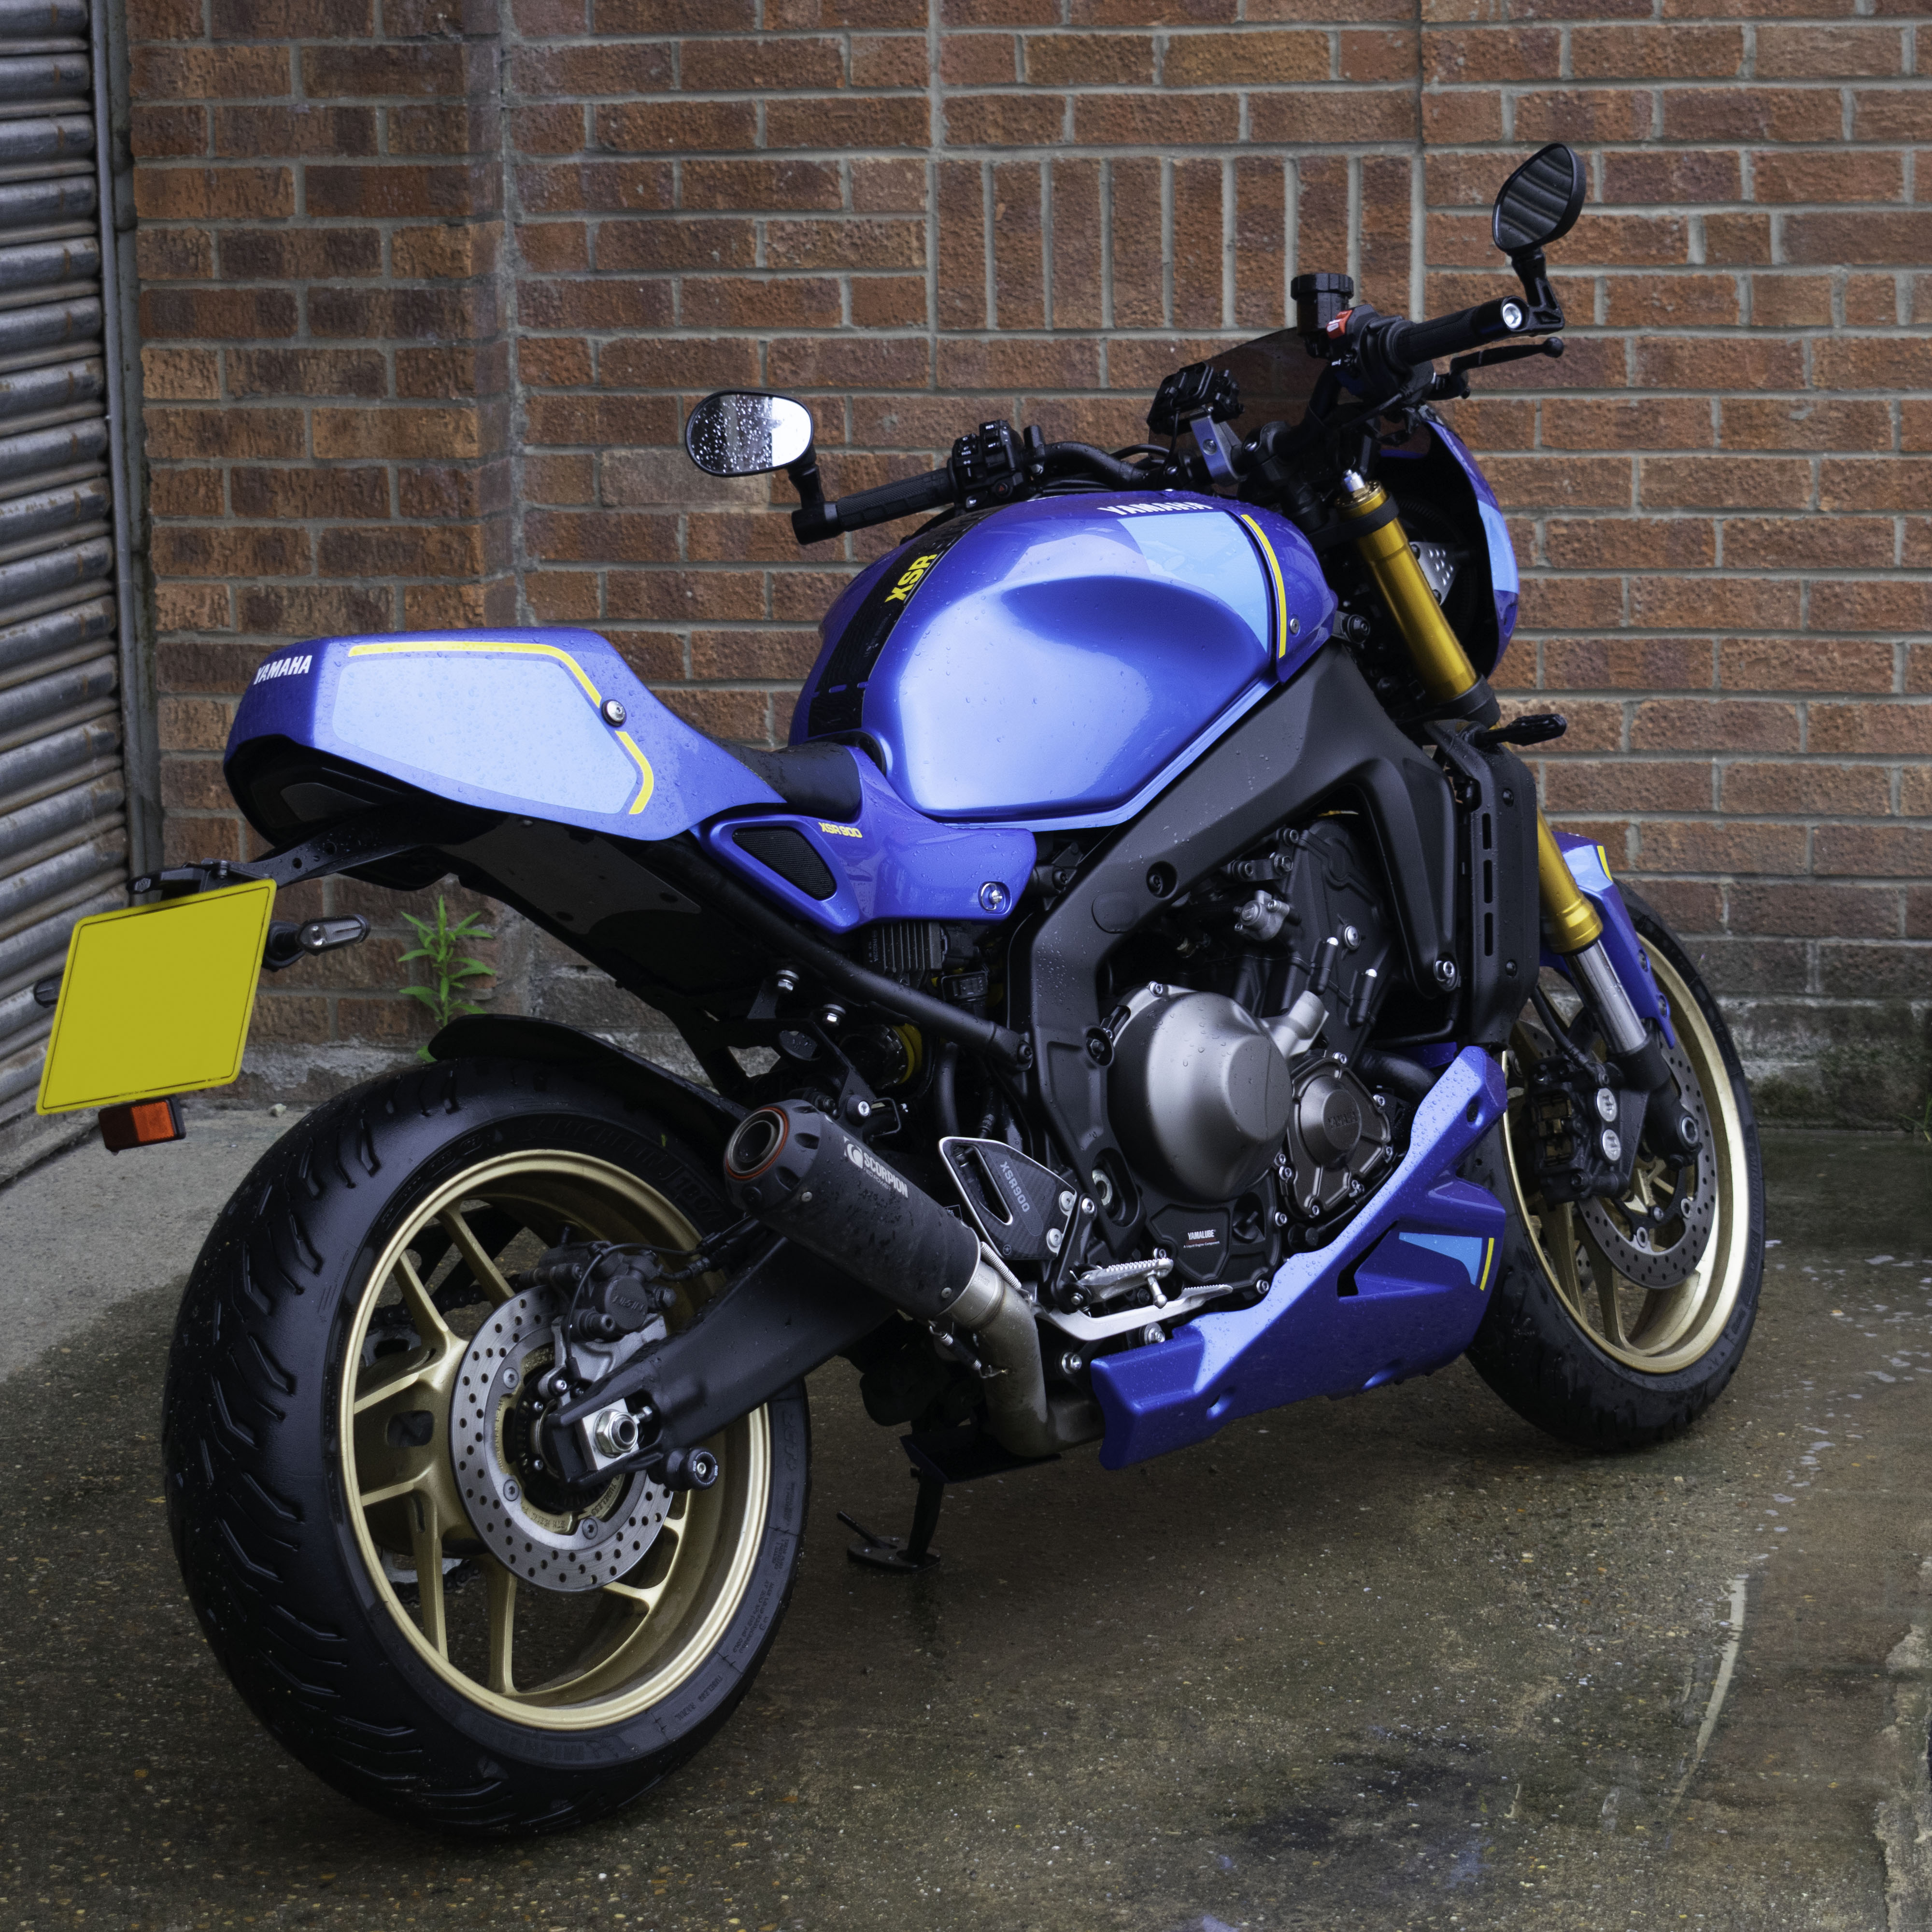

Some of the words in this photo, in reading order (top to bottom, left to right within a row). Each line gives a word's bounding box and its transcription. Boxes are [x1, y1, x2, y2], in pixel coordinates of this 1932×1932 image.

[1096, 502, 1213, 515] YAMAHA
[884, 554, 938, 603] XSR
[253, 655, 313, 685] YAMAHA
[818, 822, 863, 838] XSR900
[863, 1152, 908, 1198] SCORPION
[999, 1161, 1030, 1212] XSR900
[1187, 1229, 1215, 1240] YAMALUBE
